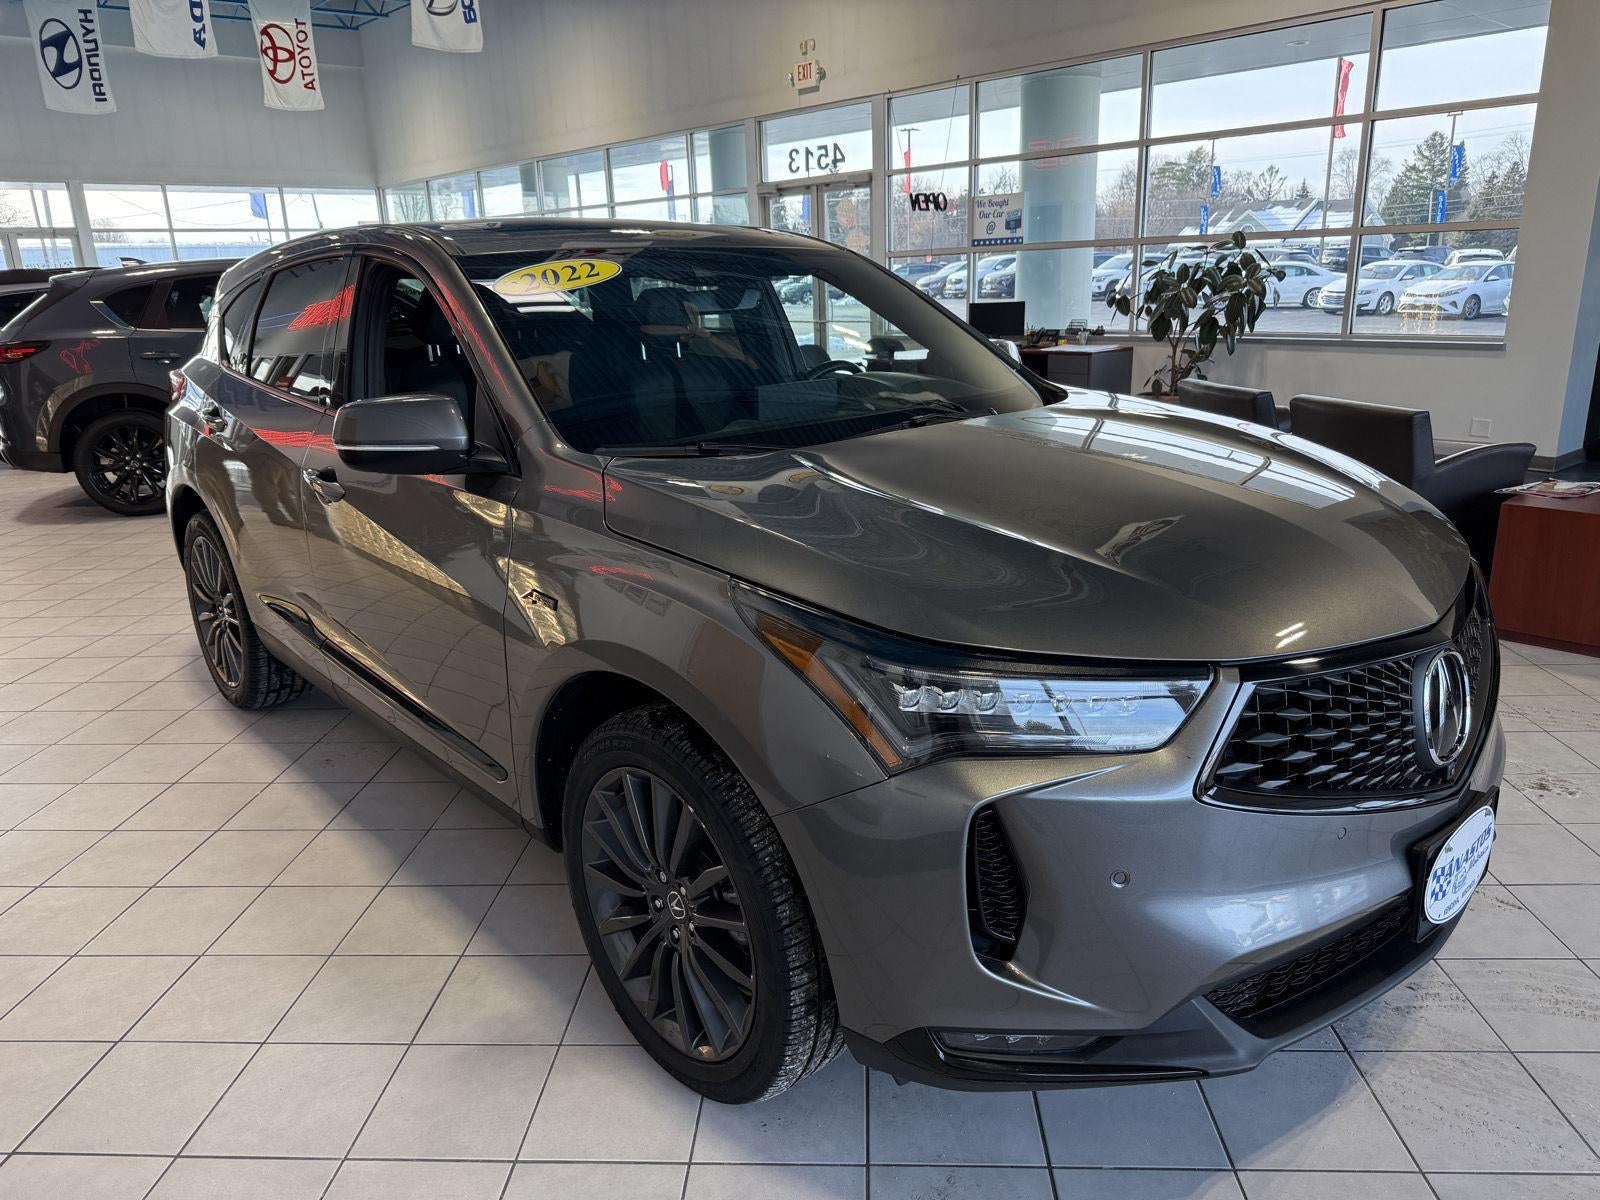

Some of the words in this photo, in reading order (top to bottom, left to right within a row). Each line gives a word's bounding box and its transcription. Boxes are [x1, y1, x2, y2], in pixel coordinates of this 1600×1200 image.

[797, 62, 813, 82] EXIT
[976, 199, 987, 208] We
[988, 198, 1009, 208] Bought
[979, 210, 991, 219] Our
[993, 209, 1005, 218] Car
[986, 221, 996, 235] @
[520, 262, 599, 292] 2022
[1444, 822, 1493, 879] ANASTOS
